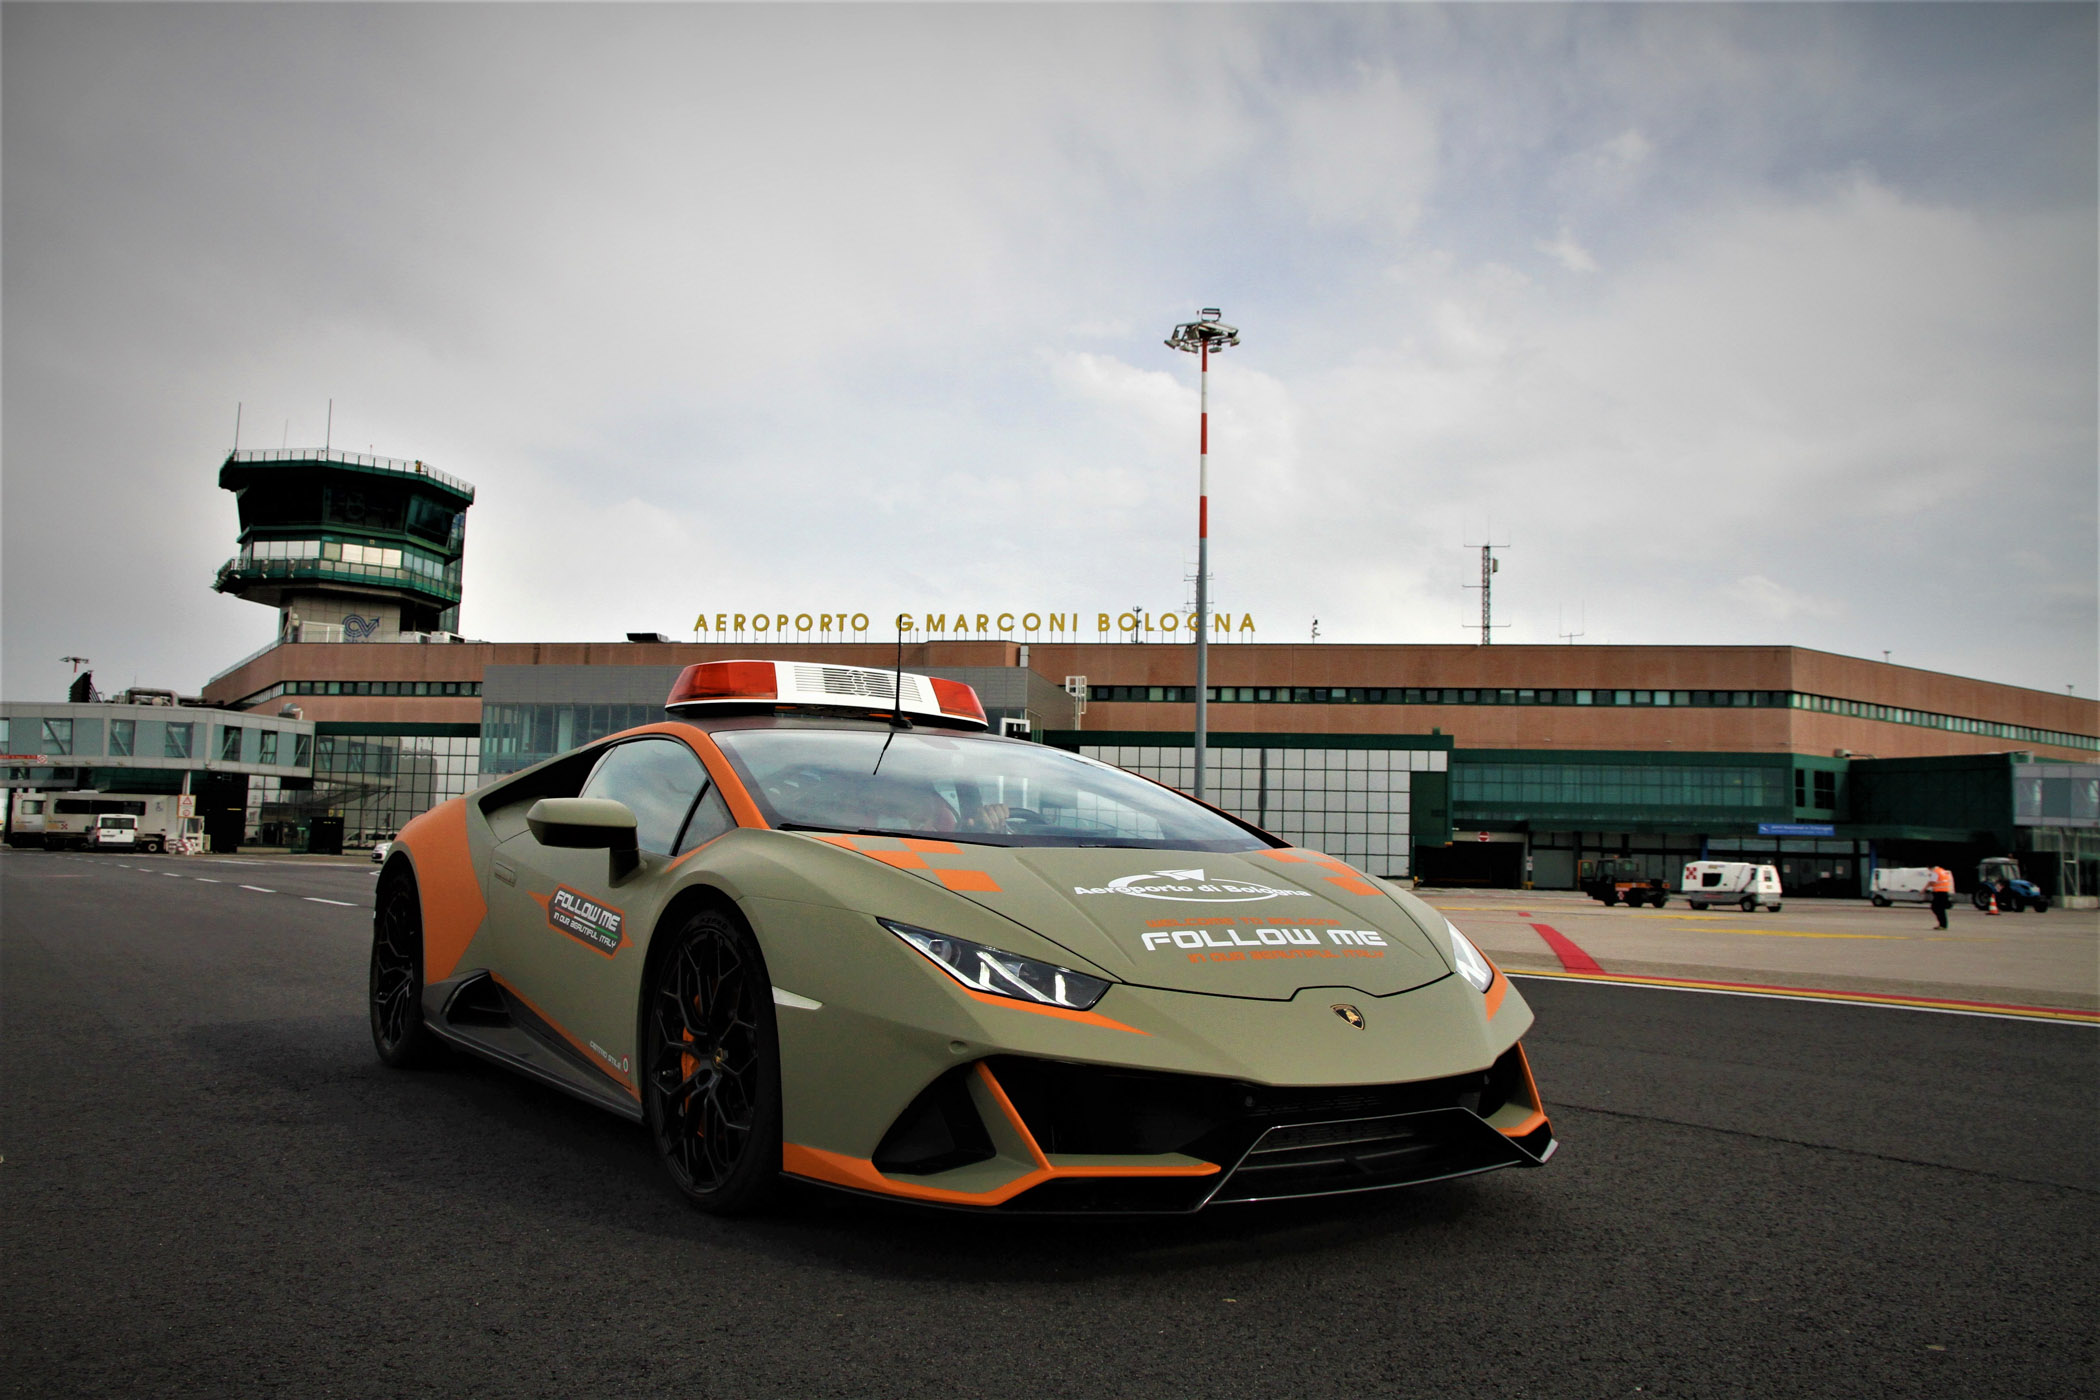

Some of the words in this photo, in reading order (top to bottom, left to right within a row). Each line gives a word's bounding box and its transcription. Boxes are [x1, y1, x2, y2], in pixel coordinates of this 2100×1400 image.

[693, 612, 870, 632] AEROPORTO
[1098, 612, 1256, 633] BOLOGNA
[1073, 884, 1195, 896] Aeroporto
[1198, 884, 1222, 893] di
[1222, 885, 1312, 897] Bologna
[554, 890, 600, 921] FOLLOW
[599, 910, 621, 932] ME
[560, 914, 570, 925] OUR
[570, 920, 598, 940] BEAUTIFUL
[599, 934, 616, 948] ITALY
[1146, 917, 1236, 928] WELCOME
[1238, 917, 1264, 926] TO
[1266, 917, 1342, 926] BOLOGNA
[1140, 928, 1321, 951] FOLLOW
[1326, 929, 1388, 947] ME
[1209, 951, 1246, 962] OUR
[1248, 949, 1341, 960] BEAUTIFUL
[1341, 949, 1385, 959] ITALY
